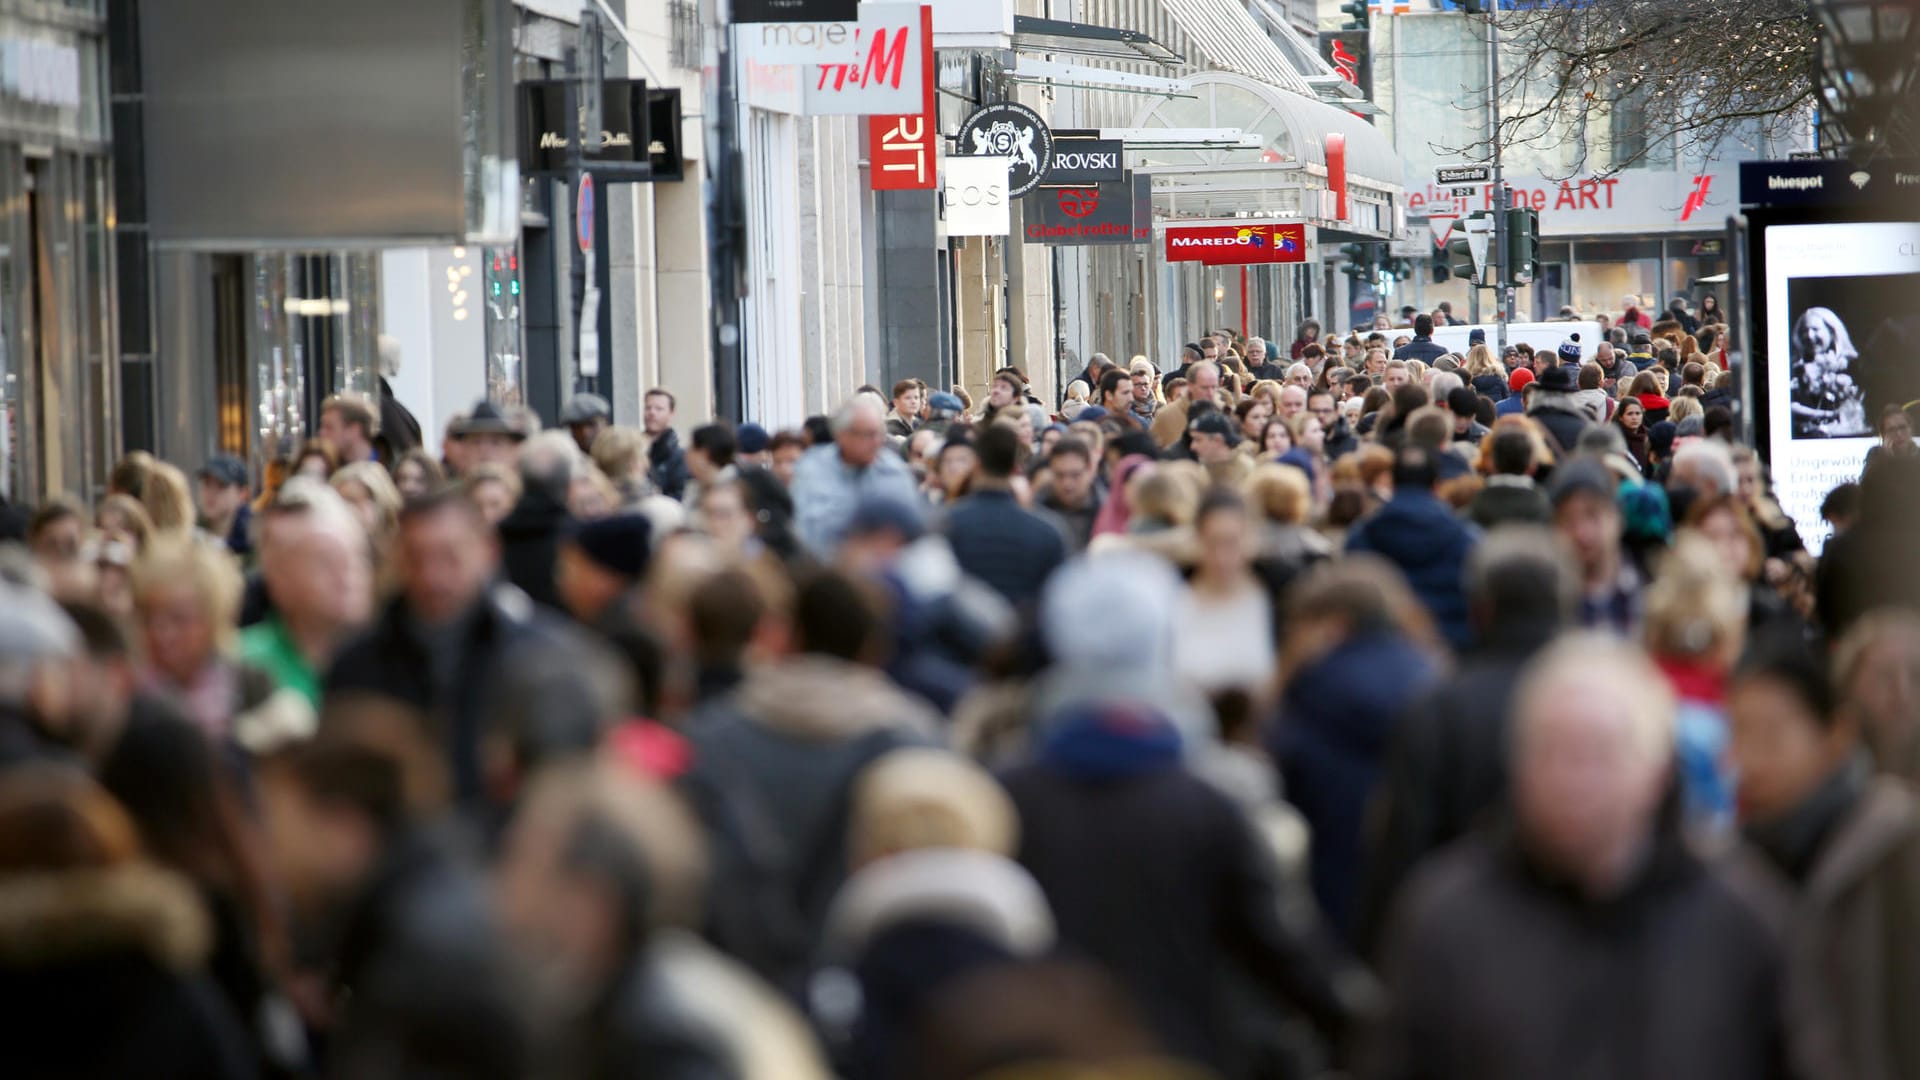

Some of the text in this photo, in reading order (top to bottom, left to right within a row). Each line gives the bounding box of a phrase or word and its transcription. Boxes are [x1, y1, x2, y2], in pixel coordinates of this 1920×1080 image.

[763, 23, 847, 48] maje
[1767, 175, 1823, 191] bluespot
[945, 184, 1001, 207] COS
[1554, 178, 1619, 211] ART
[1027, 222, 1130, 239] Globetrotter
[1171, 236, 1251, 247] MAREDO
[1790, 455, 1862, 469] Ungewöh
